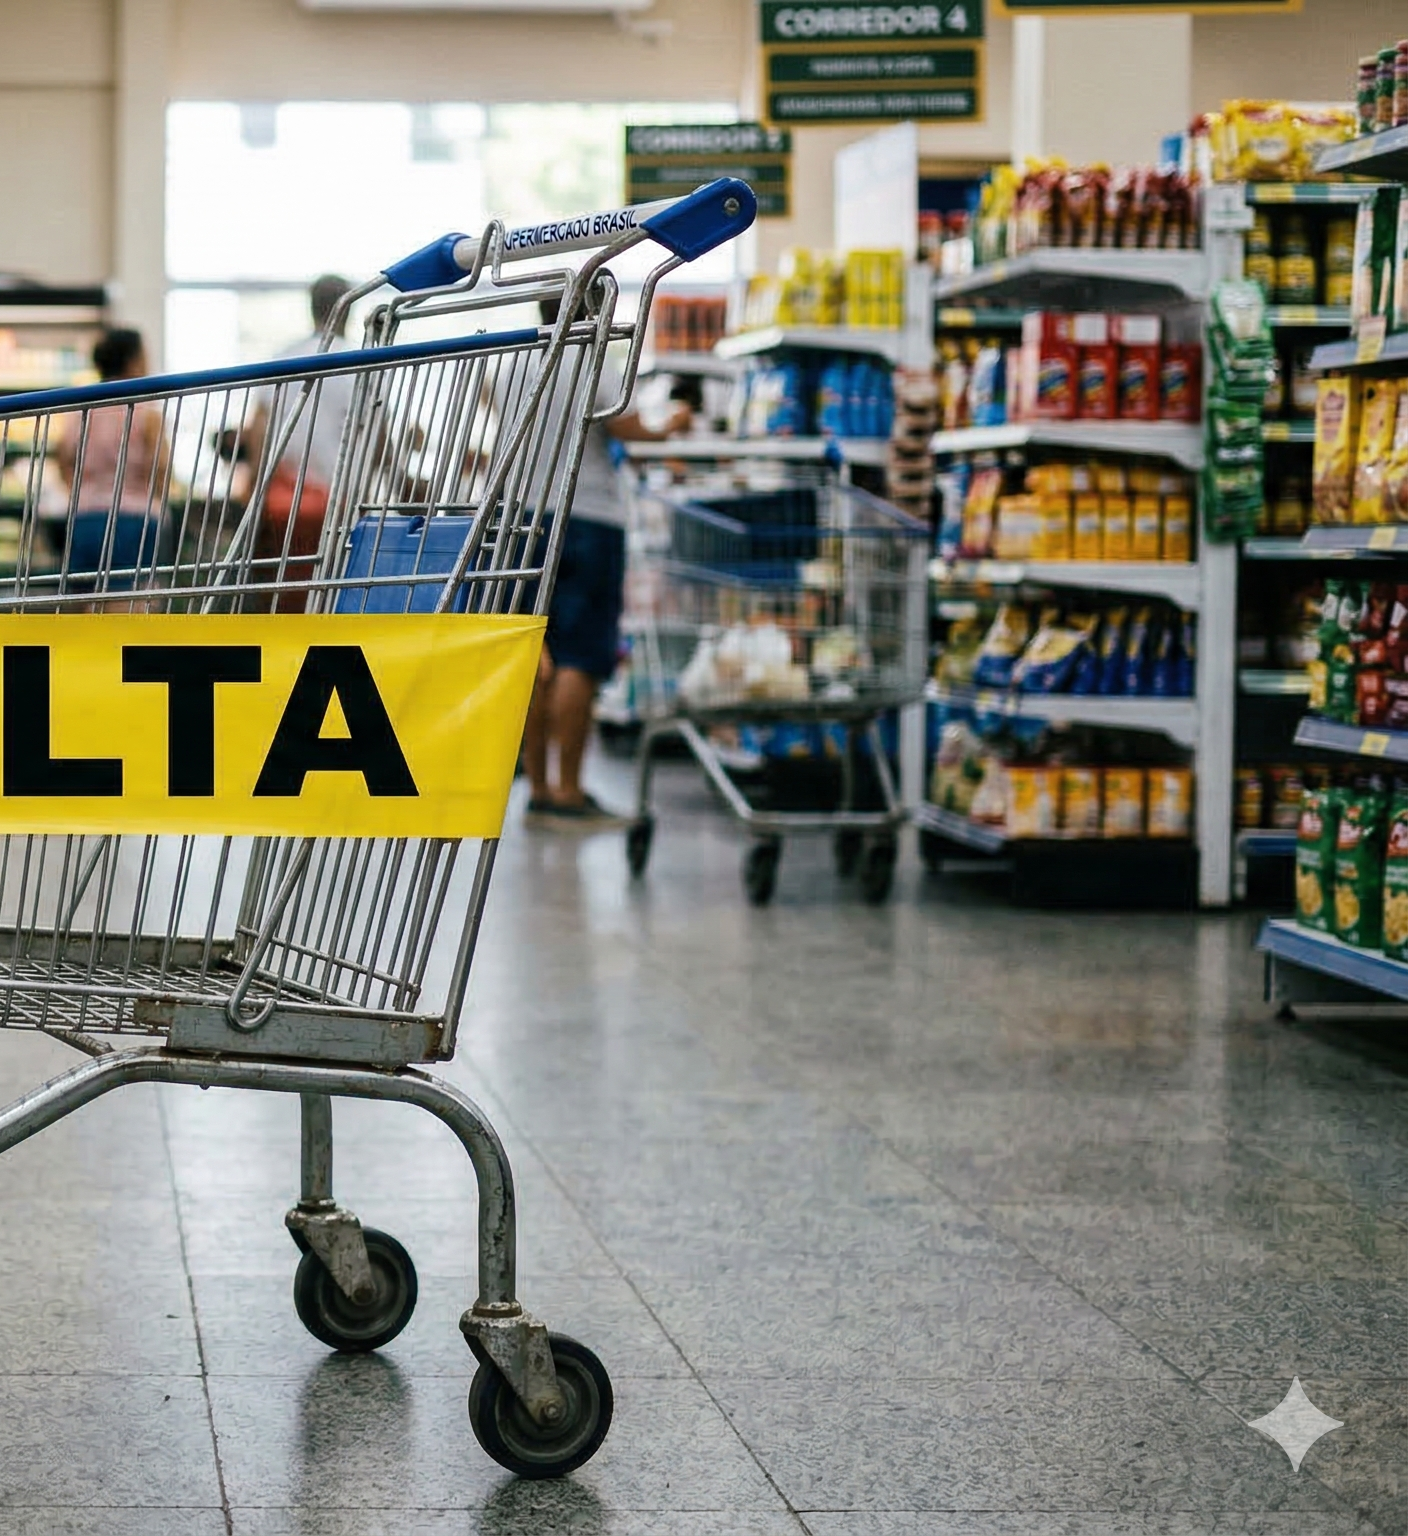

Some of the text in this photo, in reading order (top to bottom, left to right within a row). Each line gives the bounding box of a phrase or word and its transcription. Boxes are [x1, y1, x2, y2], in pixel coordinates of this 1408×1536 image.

[775, 4, 968, 37] CORREDOR 4
[503, 210, 637, 251] UPERMERCADO BRASIL
